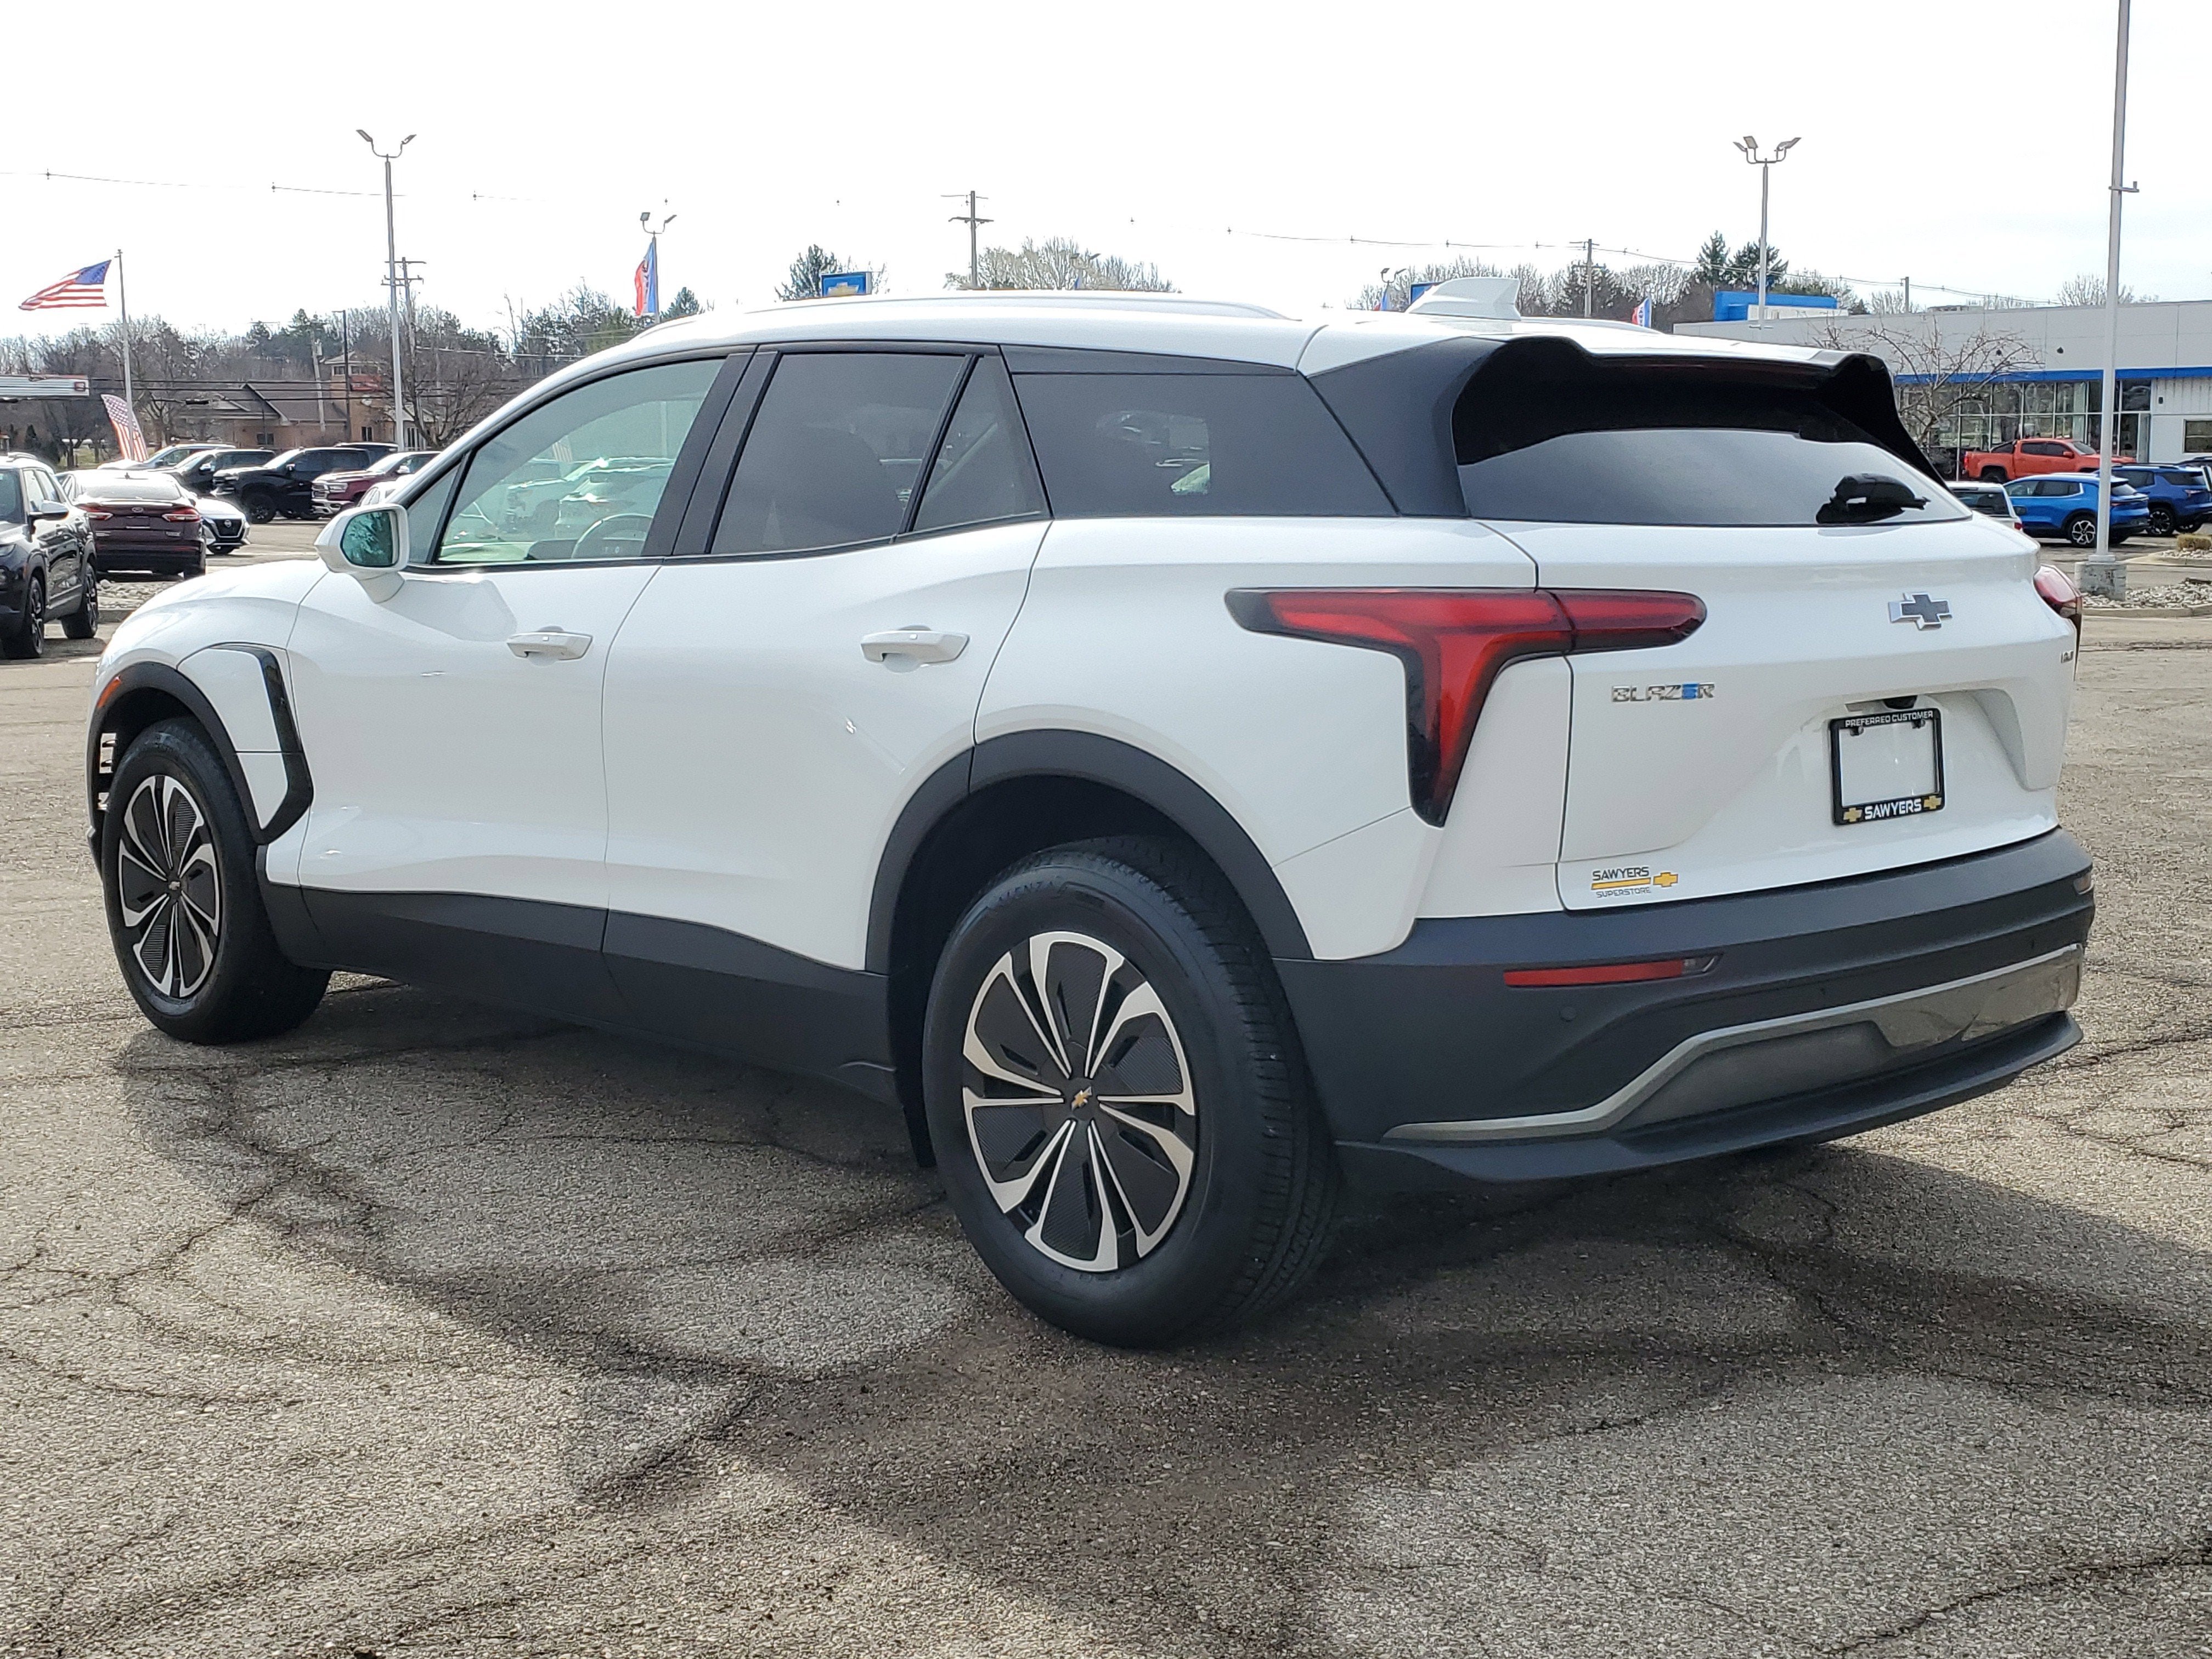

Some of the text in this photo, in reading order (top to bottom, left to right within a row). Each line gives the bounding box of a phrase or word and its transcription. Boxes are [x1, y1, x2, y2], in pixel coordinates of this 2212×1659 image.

[1612, 682, 1714, 702] BLAZER
[1845, 710, 1933, 727] PREFERRED CUSTOMER
[1864, 799, 1921, 820] SAWYERS
[1592, 867, 1649, 881] SAWYERS
[1595, 887, 1652, 899] SUPERSTORE
